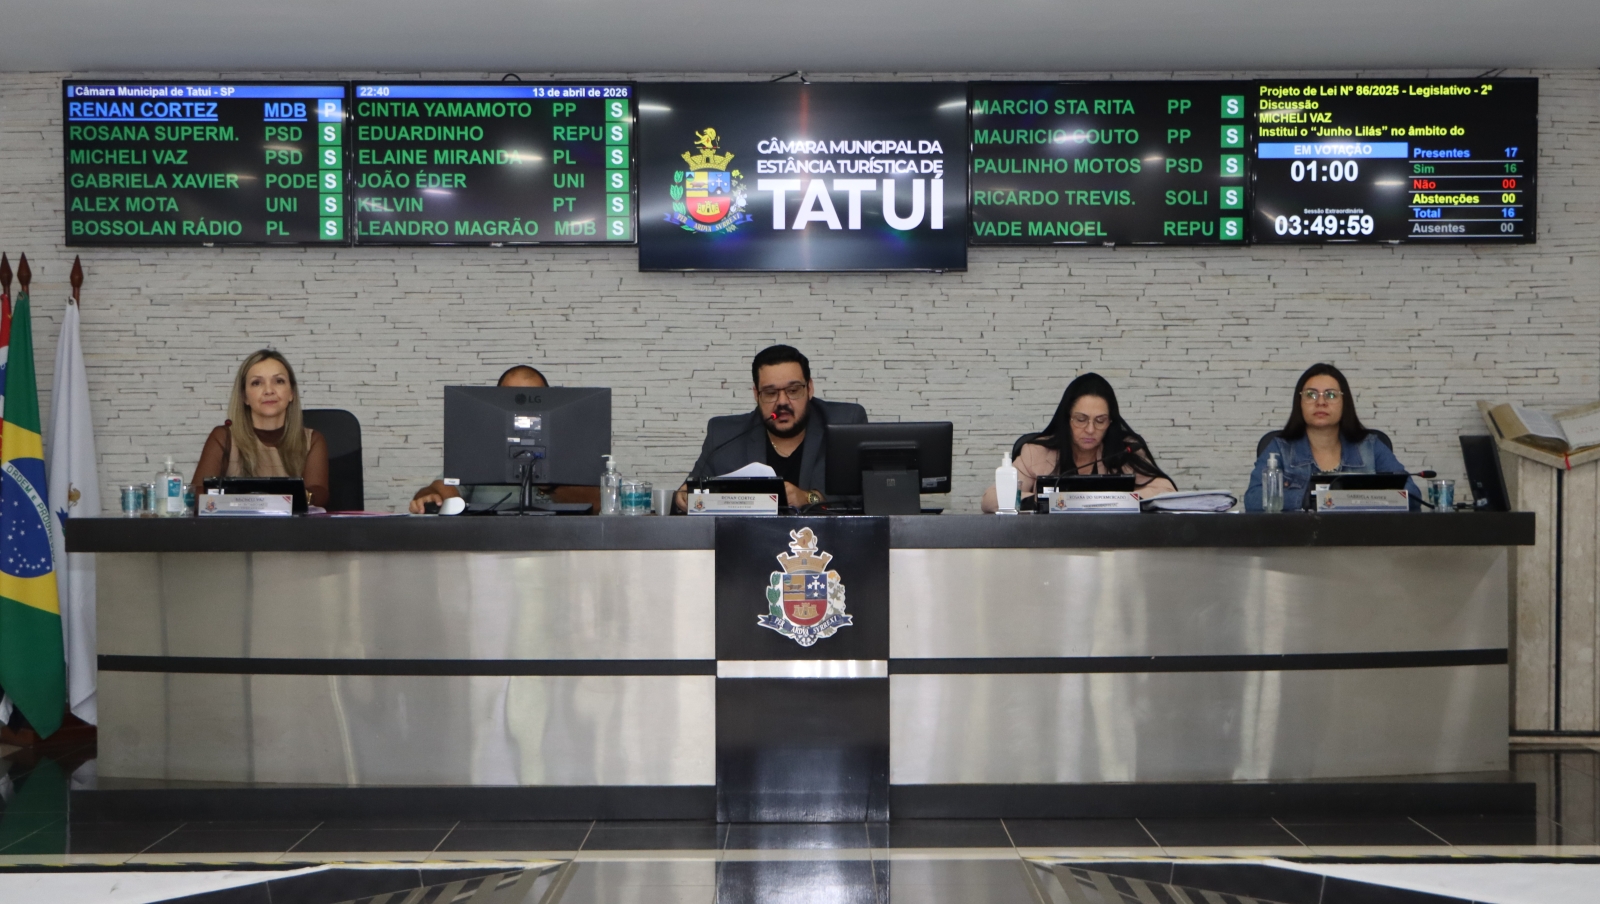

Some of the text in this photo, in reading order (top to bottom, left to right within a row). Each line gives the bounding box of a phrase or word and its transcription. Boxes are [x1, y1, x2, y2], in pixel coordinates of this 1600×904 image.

[75, 86, 115, 96] Câmara
[118, 87, 168, 98] Municipal
[171, 87, 184, 96] de
[220, 87, 235, 96] SP
[360, 87, 389, 96] 22:40
[533, 88, 628, 97] 13 de abril de 2026
[1260, 86, 1300, 98] Projeto
[1303, 86, 1317, 96] de
[1320, 86, 1337, 96] Lei
[1340, 86, 1353, 96] Nº
[1356, 86, 1399, 96] 86/2025
[1409, 85, 1471, 97] Legislativo
[1481, 85, 1492, 95] 2ª
[69, 102, 336, 118] RENAN CORTEZ MDB P
[358, 102, 623, 118] CINTIA YAMAMOTO PP S
[975, 99, 1238, 115] MARCIO STA RITA PP S
[1260, 99, 1318, 109] Discussão
[1260, 113, 1332, 123] MICHELI VAZ
[70, 126, 335, 141] ROSANA SUPERM. PSD S
[358, 126, 623, 141] EDUARDINHO REPU S
[975, 129, 1238, 144] MAURICIO COUTO PP S
[1259, 127, 1297, 136] Institui
[1391, 128, 1405, 136] no
[1408, 126, 1447, 136] âmbito
[1450, 125, 1465, 136] do
[758, 138, 942, 154] CÂMARA MUNICIPAL DA
[1294, 142, 1372, 157] EM VOTAÇÃO
[1414, 148, 1517, 158] Presentes 17
[70, 150, 336, 165] MICHELI VAZ PSD S
[359, 150, 623, 165] ELAINE MIRANDA PL S
[758, 157, 943, 173] ESTÂNCIA TURÍSTICA DE
[975, 158, 1238, 173] PAULINHO MOTOS PSD S
[1291, 161, 1358, 182] 01:00
[1414, 164, 1517, 174] Sim 16
[71, 174, 336, 189] GABRIELA XAVIER PODE S
[358, 170, 623, 189] JOÃO ÉDER UNI S
[1414, 179, 1516, 189] Não 00
[71, 197, 337, 212] ALEX MOTA UNI S
[358, 197, 624, 212] KELVIN PT S
[758, 173, 943, 230] TATUÍ
[975, 190, 1237, 205] RICARDO TREVIS. SOLI S
[1413, 194, 1515, 205] Abstenções 00
[1413, 208, 1515, 218] Total 16
[72, 217, 337, 236] BOSSOLAN RÁDIO PL S
[358, 218, 624, 236] LEANDRO MAGRÃO MDB S
[974, 221, 1237, 236] VADE MANOEL REPU S
[1275, 215, 1374, 236] 03:49:59
[1413, 223, 1514, 233] Ausentes 00
[6, 465, 33, 493] ORDEM
[774, 618, 785, 627] PER
